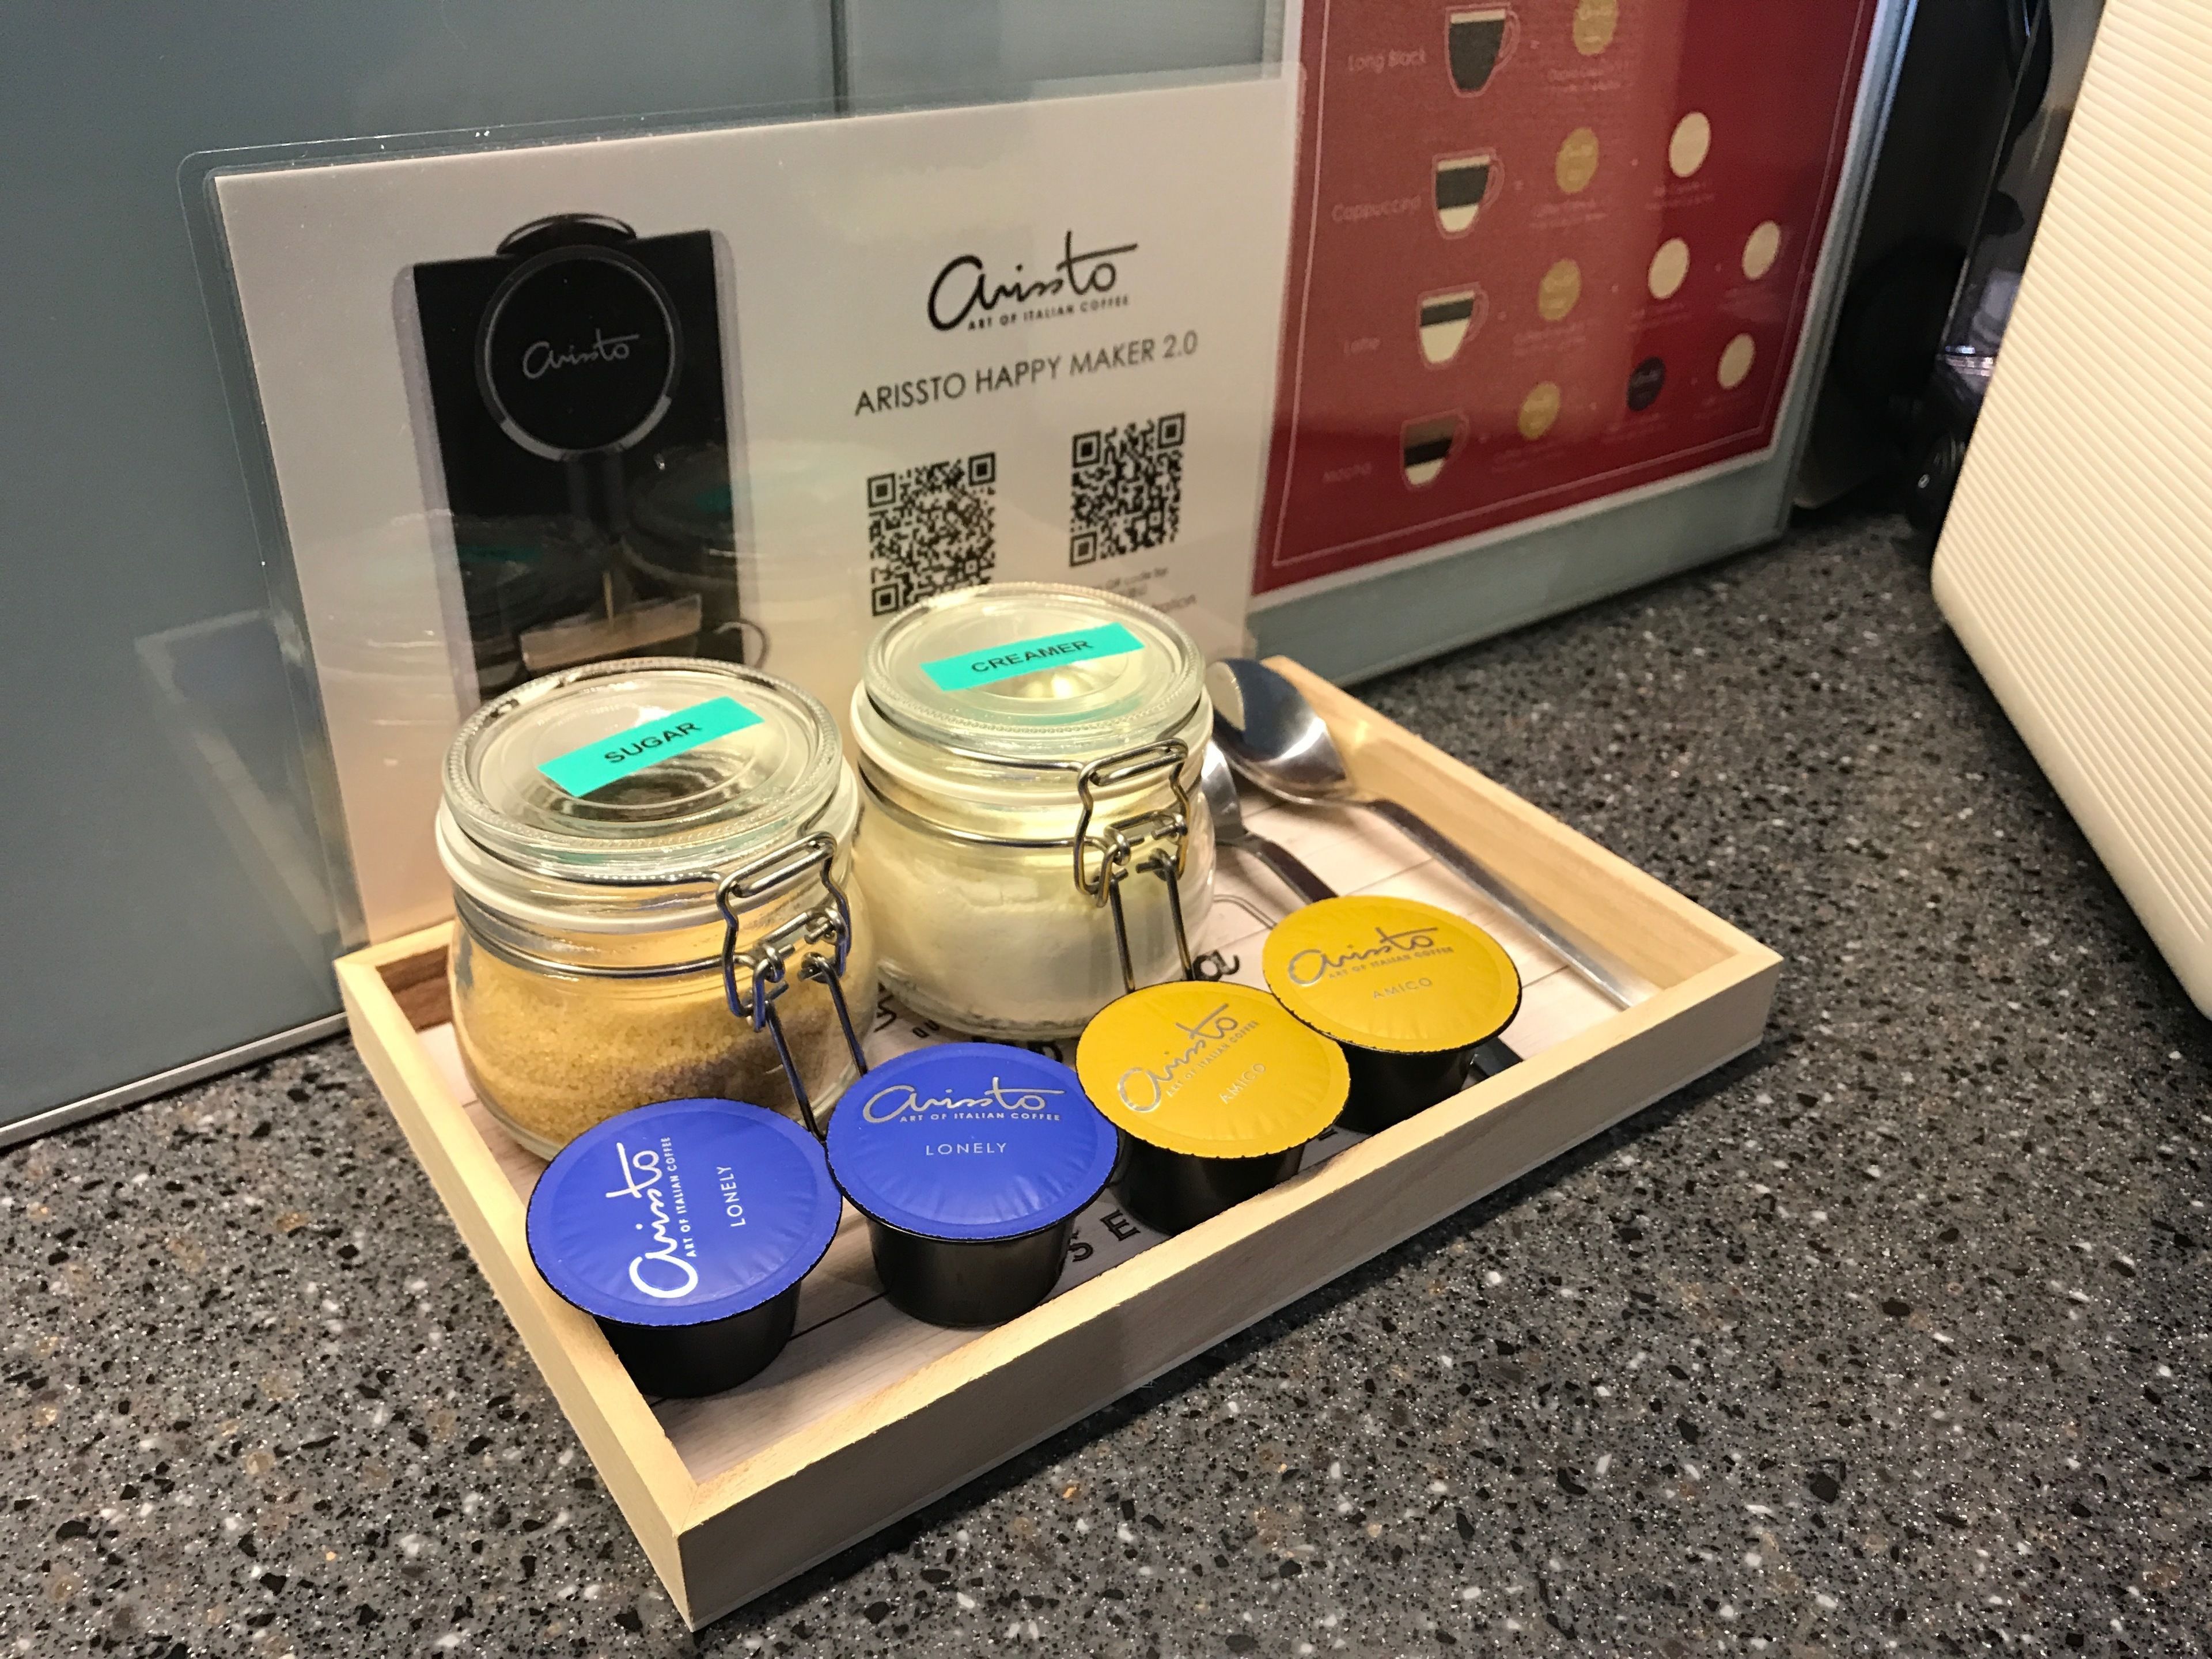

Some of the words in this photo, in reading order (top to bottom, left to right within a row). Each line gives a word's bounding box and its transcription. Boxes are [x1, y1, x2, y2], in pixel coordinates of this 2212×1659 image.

[968, 314, 993, 331] ART
[999, 308, 1017, 326] OF
[1024, 301, 1074, 321] ITALIAN
[1080, 294, 1130, 313] COFFEE
[854, 372, 967, 416] ARISSTO
[975, 355, 1062, 395] HAPPY
[1069, 338, 1154, 377] MAKER
[1162, 329, 1198, 358] 2.0
[972, 641, 1092, 673] CREAMER
[604, 722, 701, 763] SUGAR
[1351, 964, 1366, 973] OF
[1369, 954, 1411, 968] ITALIAN
[1414, 946, 1454, 959] COFFEE
[1373, 978, 1432, 999] AMICO
[1184, 1069, 1197, 1080] OF
[1198, 1043, 1230, 1069] ITALIAN
[1229, 1020, 1260, 1043] COFFEE
[1218, 1063, 1266, 1104] AMICO
[900, 1115, 923, 1123] ART
[1010, 1112, 1061, 1122] COFFEE
[660, 1137, 677, 1172] COFFEE
[926, 1142, 1007, 1156] LONELY
[669, 1175, 687, 1215] ITALIAN
[716, 1166, 747, 1228] LONELY
[679, 1218, 691, 1233] OF
[682, 1237, 697, 1257] ART
